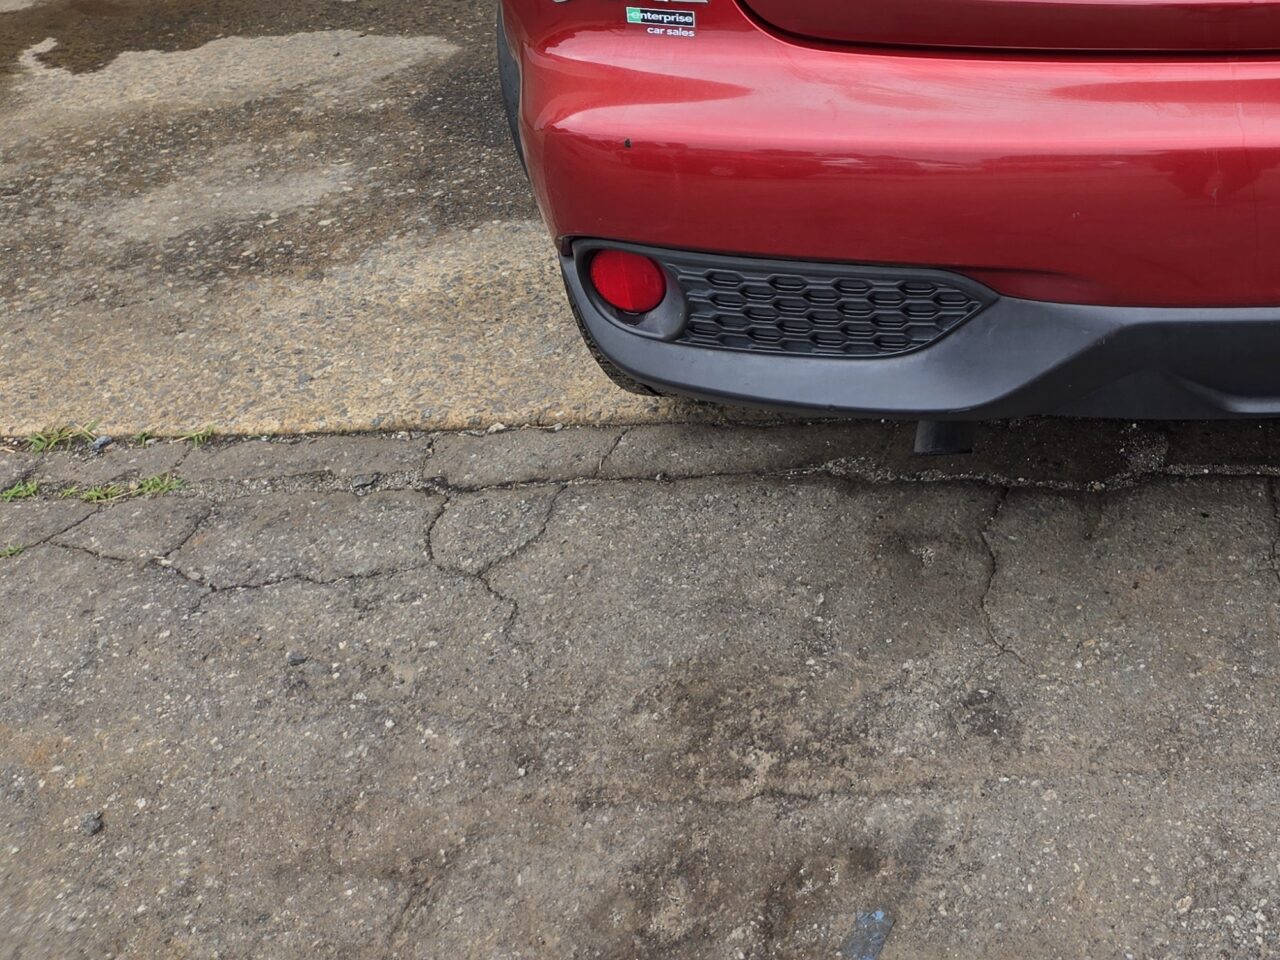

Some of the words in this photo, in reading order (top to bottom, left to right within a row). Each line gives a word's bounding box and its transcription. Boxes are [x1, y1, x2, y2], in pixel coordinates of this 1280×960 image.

[630, 10, 693, 23] enterprise
[647, 26, 665, 35] car
[666, 27, 695, 37] sales
